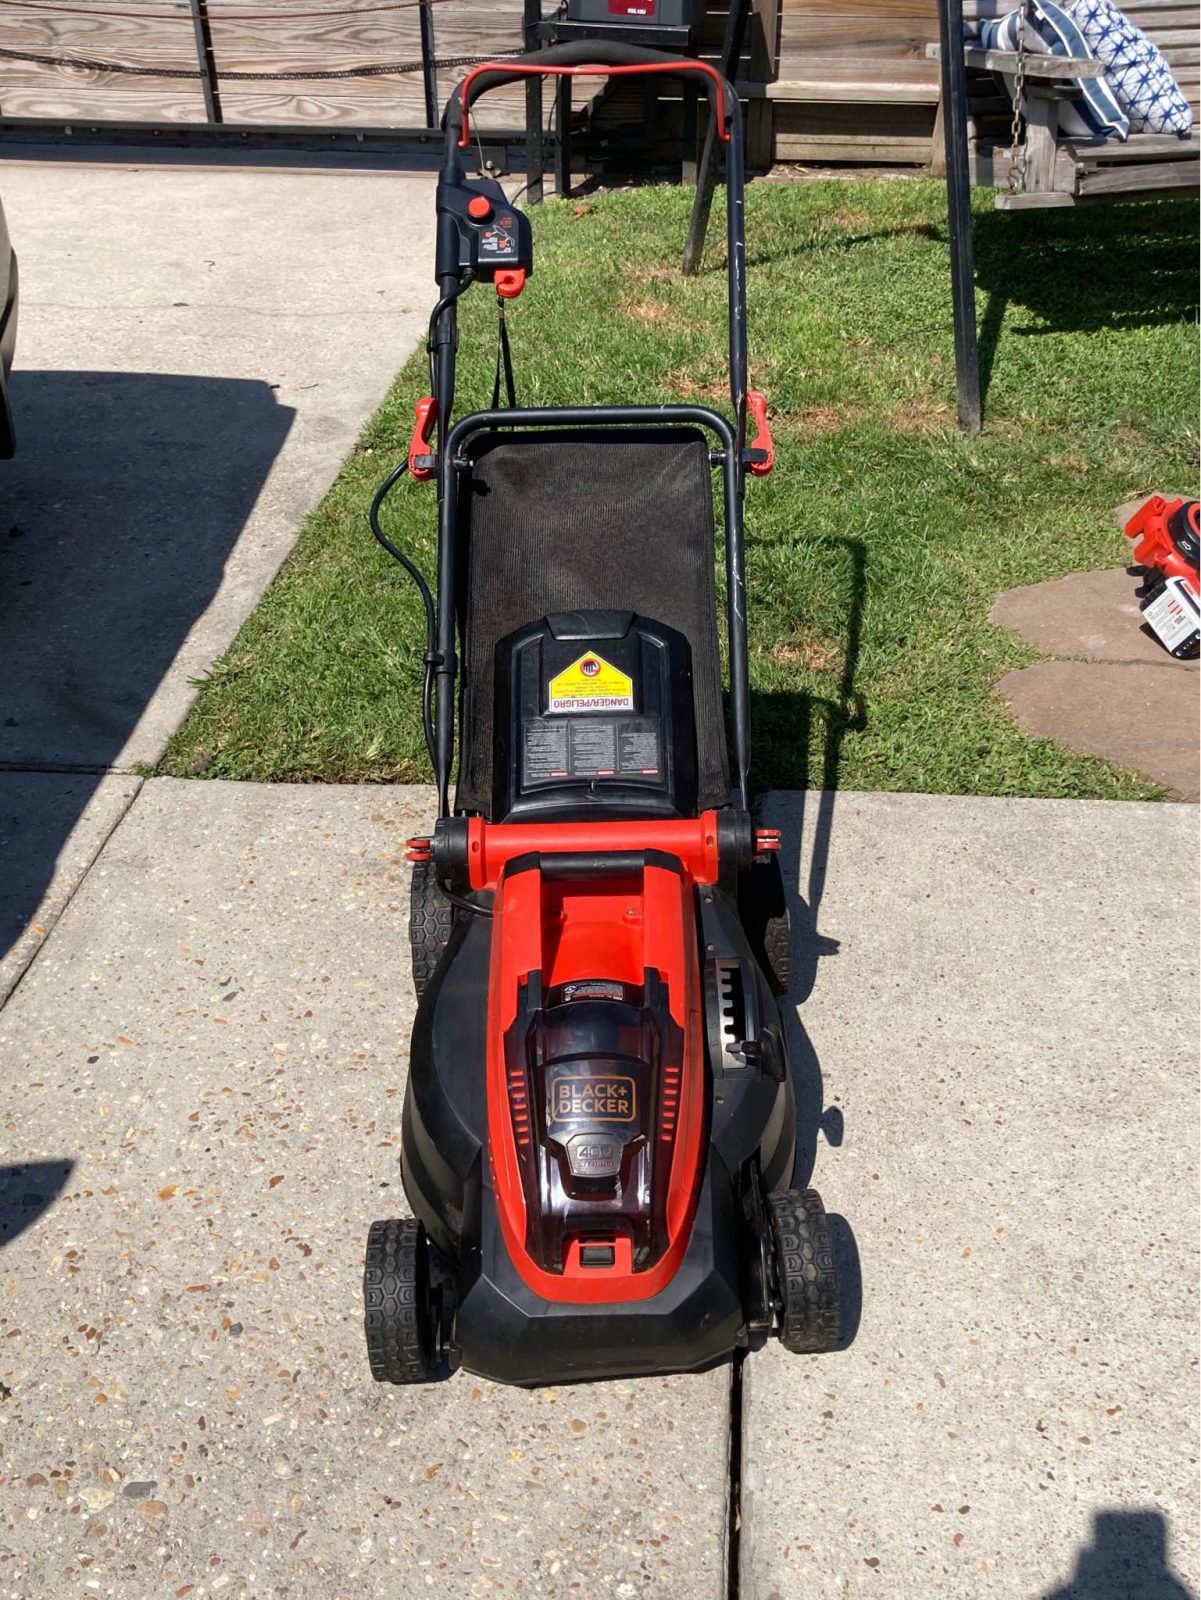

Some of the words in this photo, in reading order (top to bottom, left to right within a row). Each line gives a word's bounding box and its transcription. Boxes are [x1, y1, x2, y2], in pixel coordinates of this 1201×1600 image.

[553, 698, 629, 709] DANGER/PELIGRO
[559, 1084, 628, 1099] BLACK+
[559, 1099, 628, 1113] DECKER
